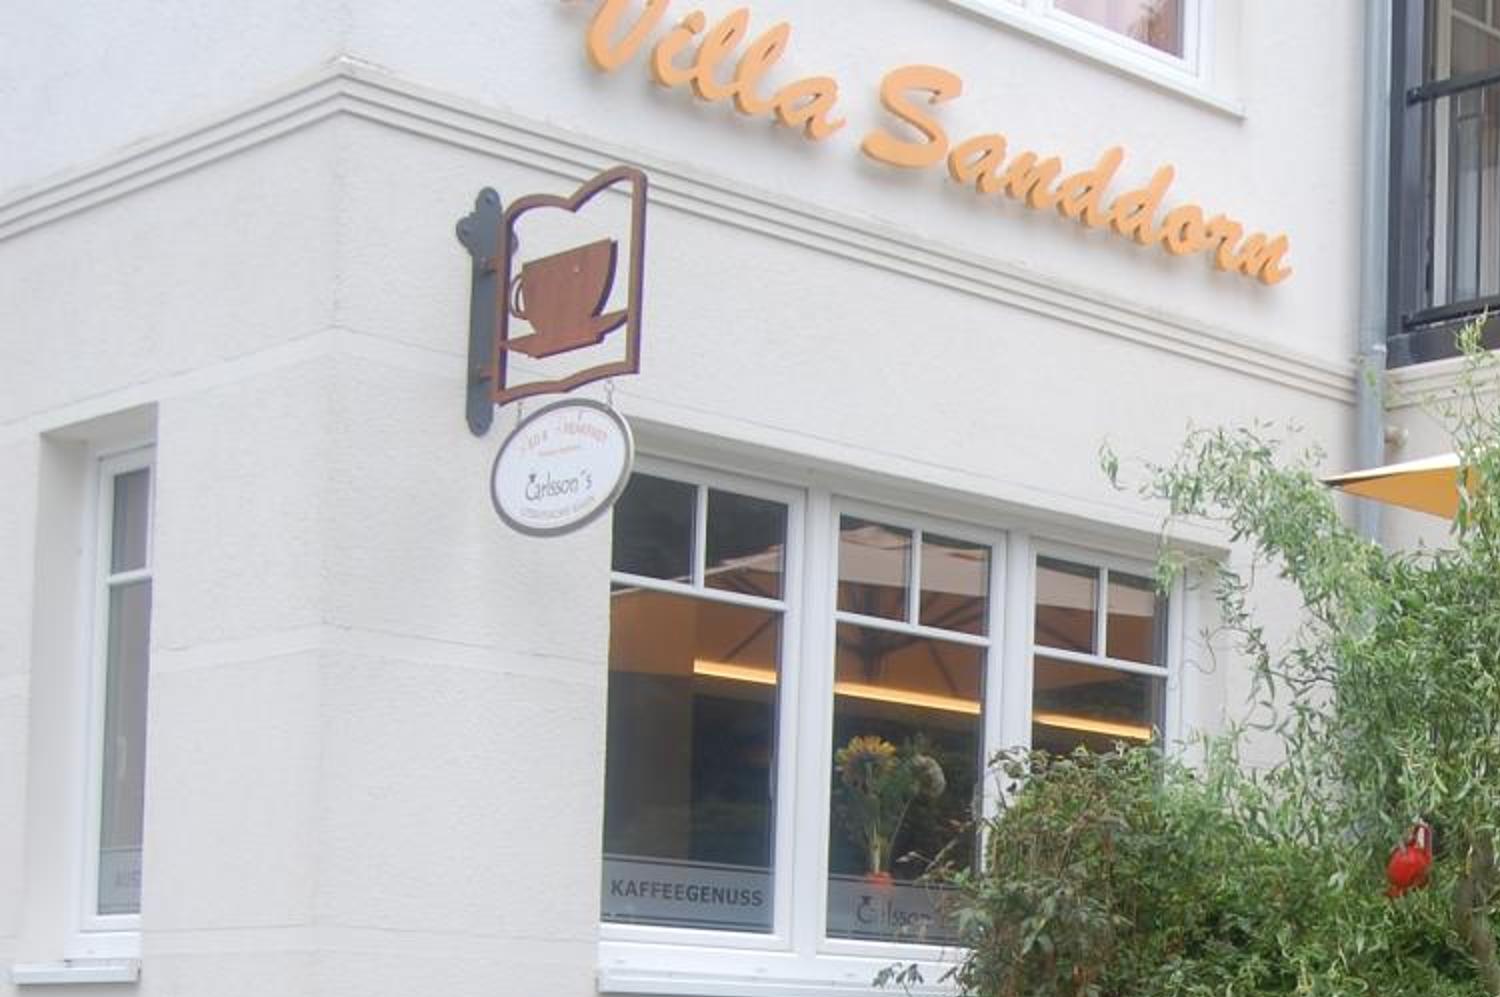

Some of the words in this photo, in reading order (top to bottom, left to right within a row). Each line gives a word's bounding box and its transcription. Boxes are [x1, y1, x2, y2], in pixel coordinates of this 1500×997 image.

[562, 0, 848, 141] Villa
[860, 63, 1293, 287] Sanddorn
[609, 878, 764, 909] KAFFEEGENUSS
